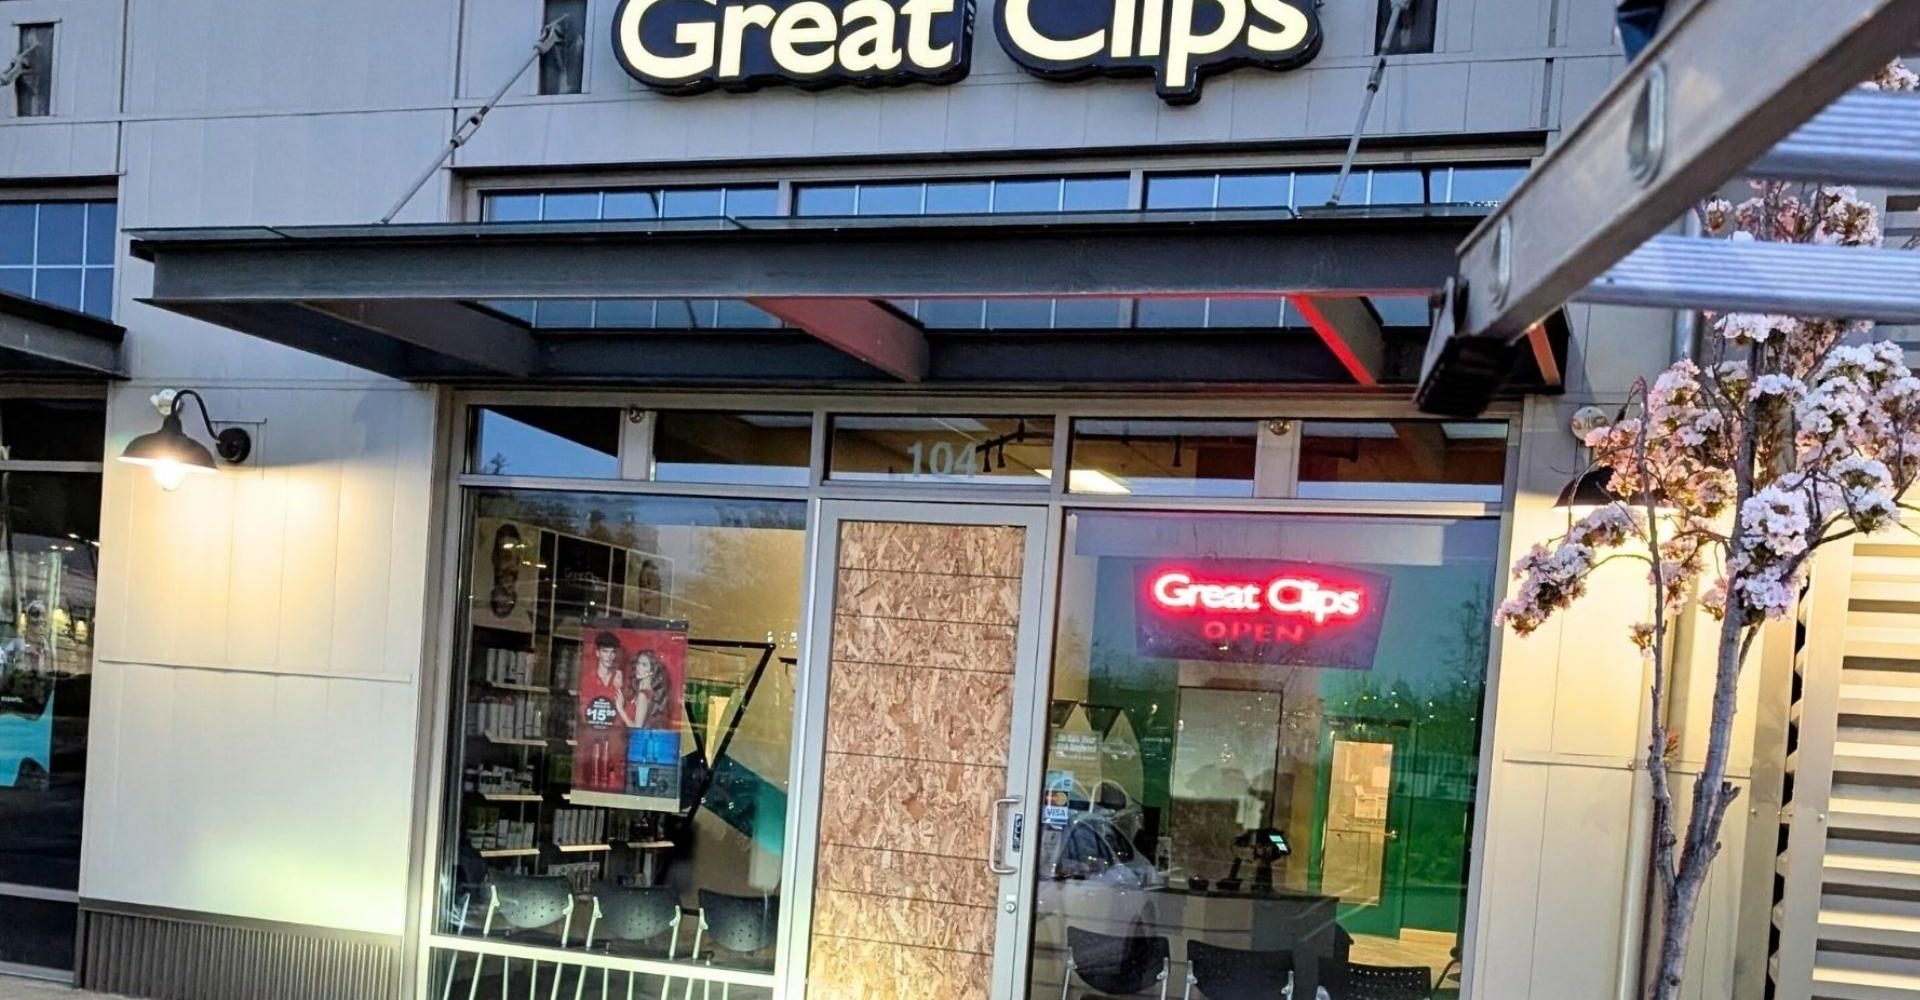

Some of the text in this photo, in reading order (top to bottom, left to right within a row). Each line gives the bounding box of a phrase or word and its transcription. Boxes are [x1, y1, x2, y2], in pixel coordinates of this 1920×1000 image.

[619, 0, 1309, 87] Great Clips
[907, 440, 977, 479] 104
[1153, 572, 1361, 623] Great Clips
[1204, 620, 1305, 644] OPEN
[1047, 808, 1066, 818] VISA
